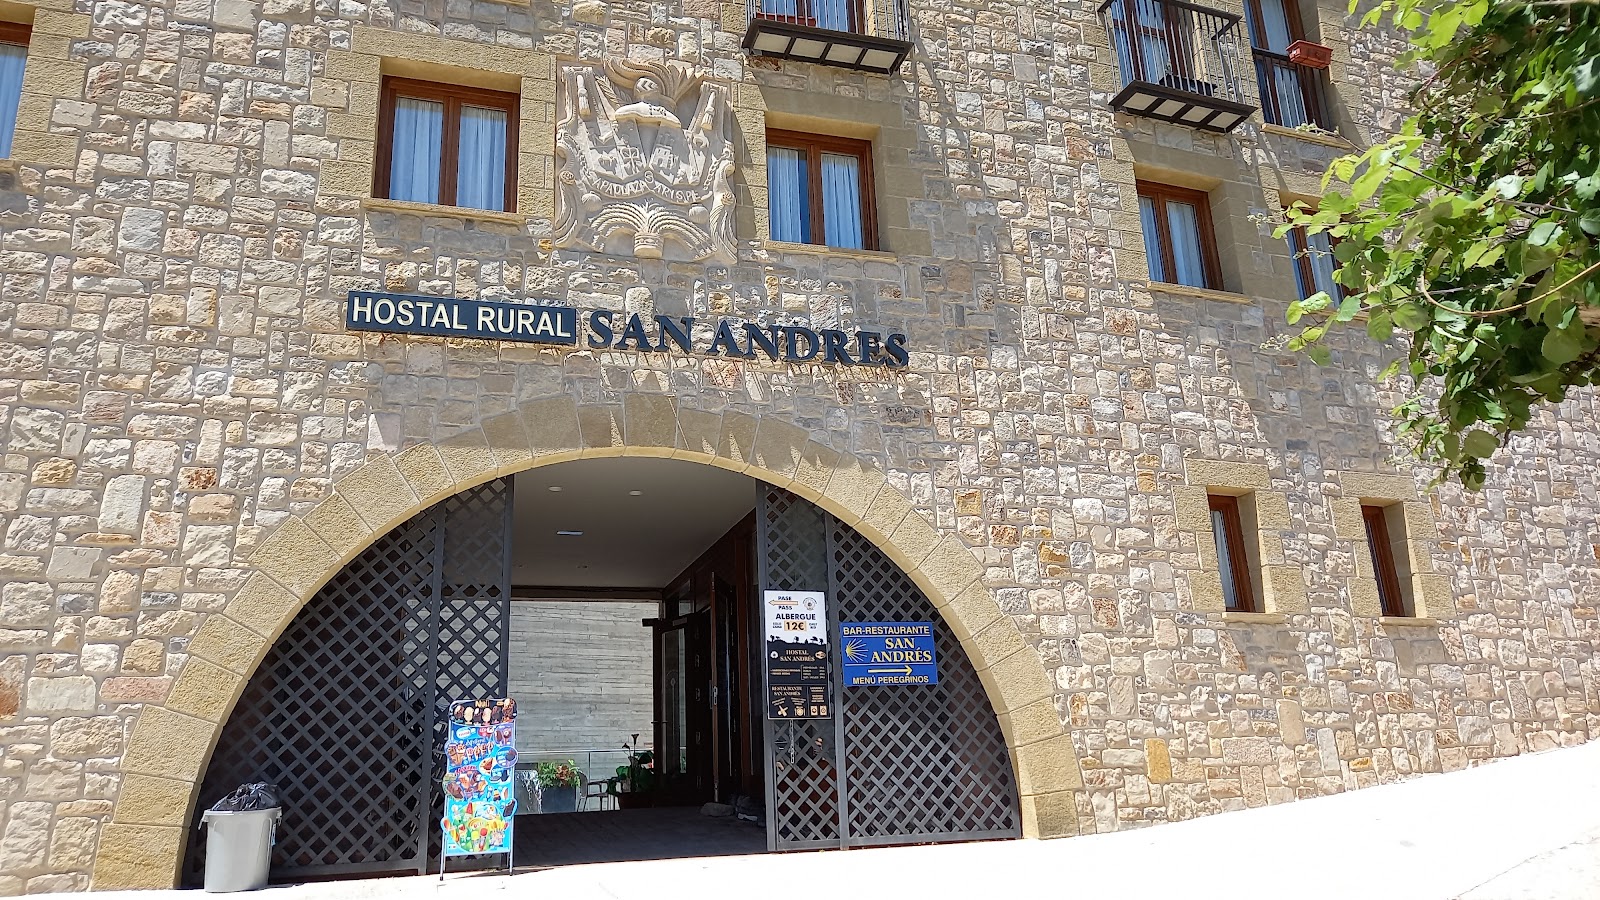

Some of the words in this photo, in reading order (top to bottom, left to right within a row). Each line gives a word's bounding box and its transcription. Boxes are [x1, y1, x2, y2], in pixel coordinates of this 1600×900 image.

[352, 296, 468, 330] HOSTAL
[477, 306, 571, 337] RURAL
[587, 310, 696, 355] SAN
[704, 319, 910, 368] ANDRES
[785, 621, 805, 631] 12€
[843, 626, 930, 635] BAR-RESTAURANTE
[885, 637, 915, 649] SAN
[871, 646, 932, 663] ANDRÉS
[852, 674, 876, 685] MENÚ
[877, 675, 929, 684] PEREGRINOS
